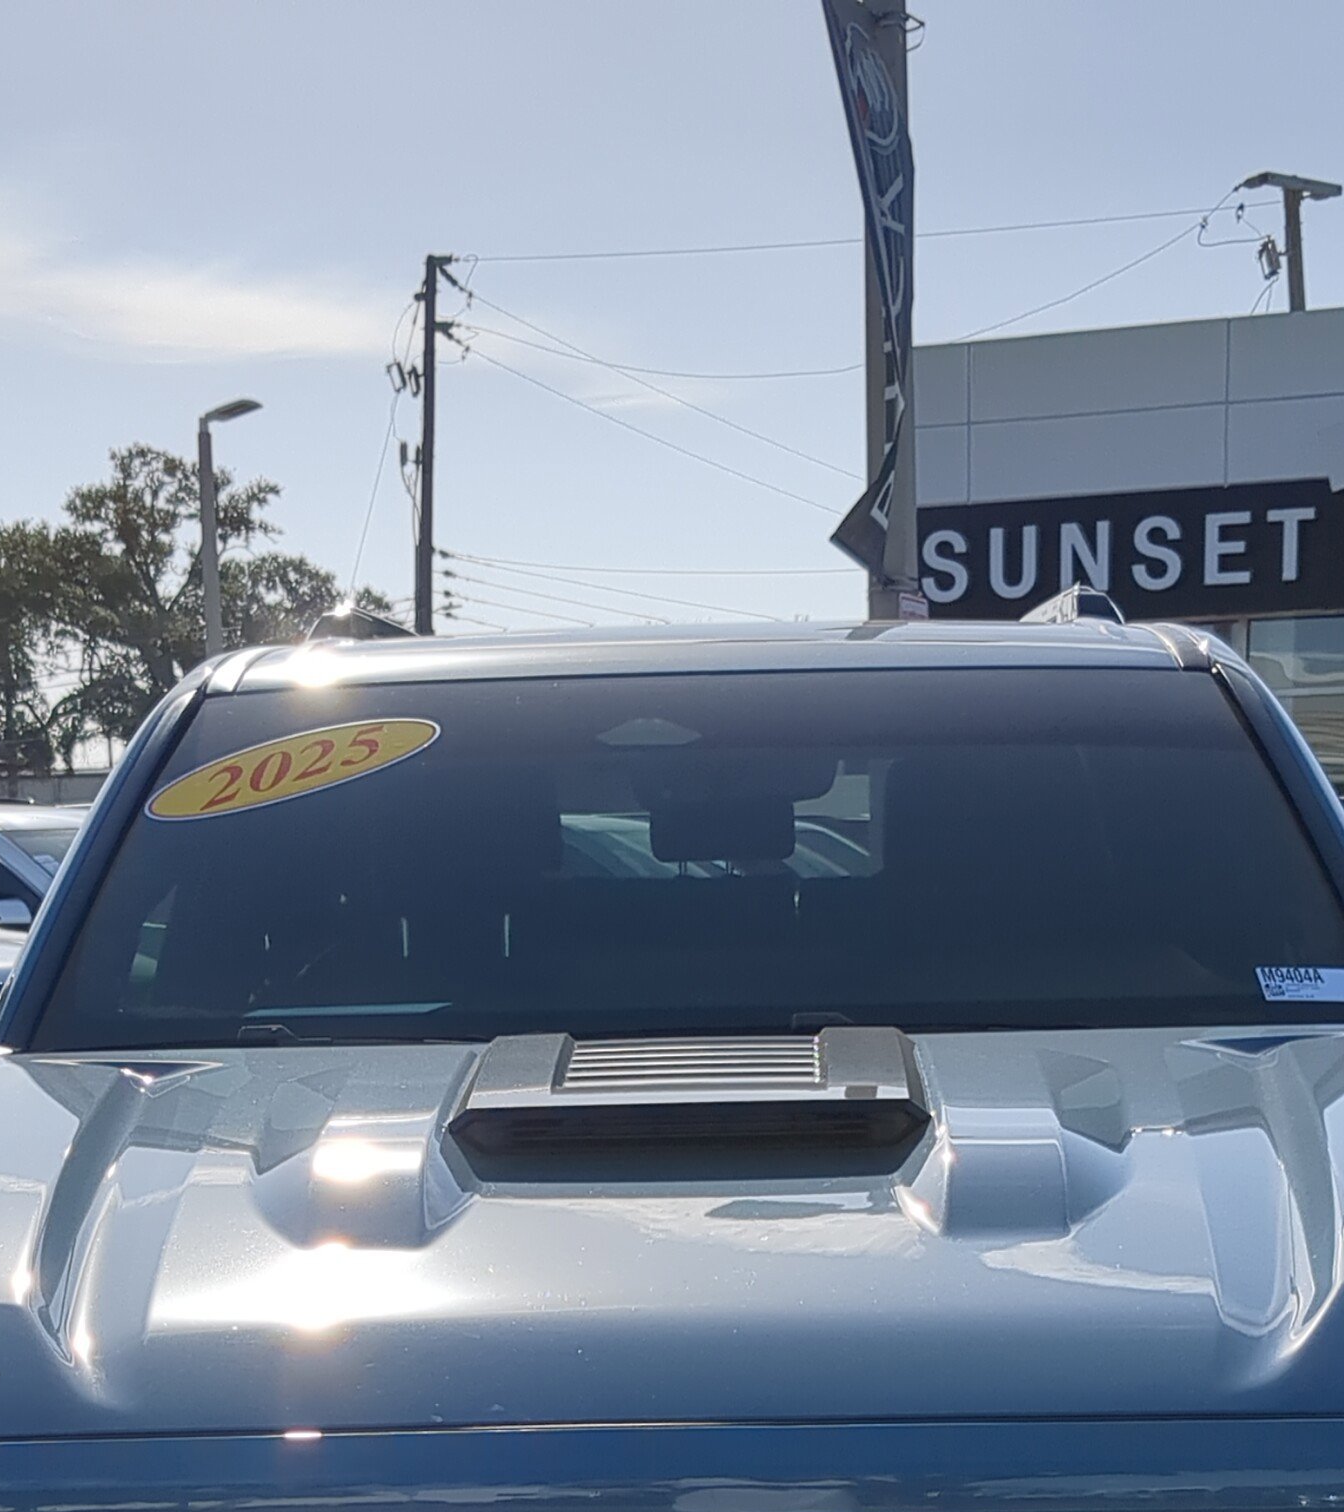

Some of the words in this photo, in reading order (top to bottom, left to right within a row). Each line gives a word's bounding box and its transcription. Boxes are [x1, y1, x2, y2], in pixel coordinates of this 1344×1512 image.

[920, 507, 1318, 604] SUNSET
[199, 724, 385, 811] 2025
[1260, 967, 1325, 984] M9404A
